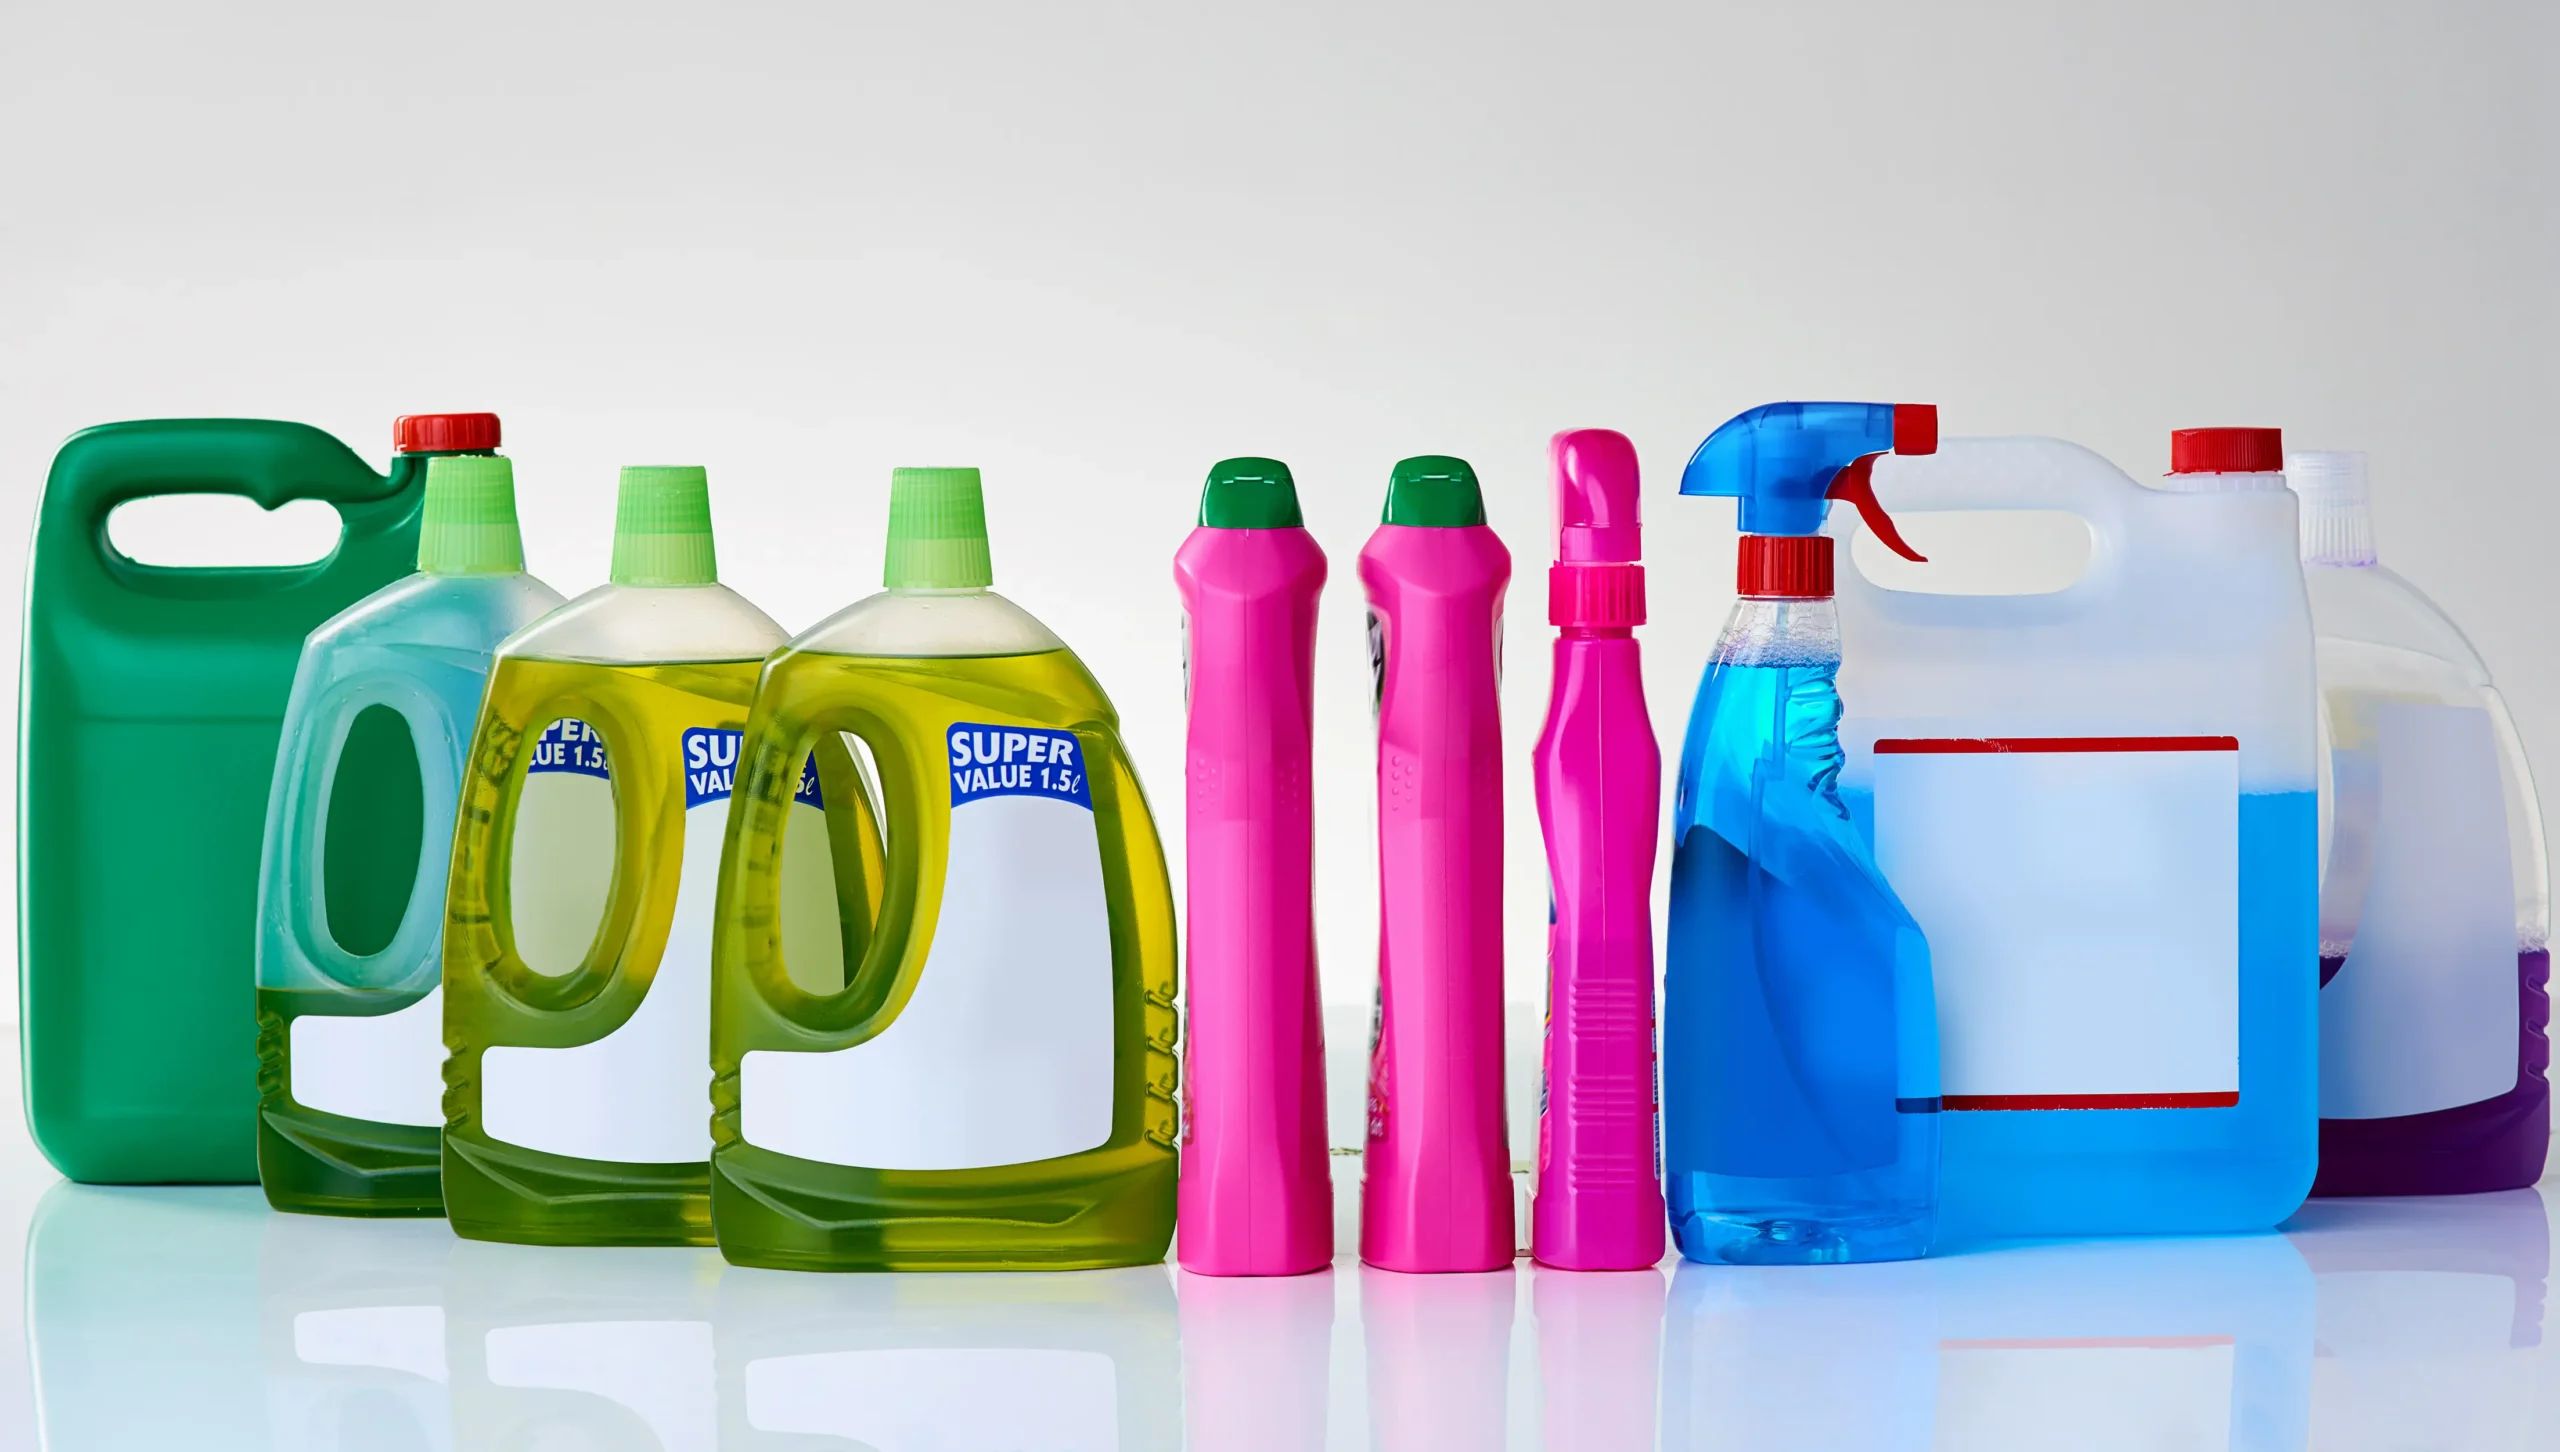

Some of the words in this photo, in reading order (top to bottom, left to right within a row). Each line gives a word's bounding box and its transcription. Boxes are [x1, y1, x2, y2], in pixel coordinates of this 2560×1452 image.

[687, 734, 744, 769] SU
[951, 731, 1074, 767] SUPER
[953, 765, 1033, 794] VALUE
